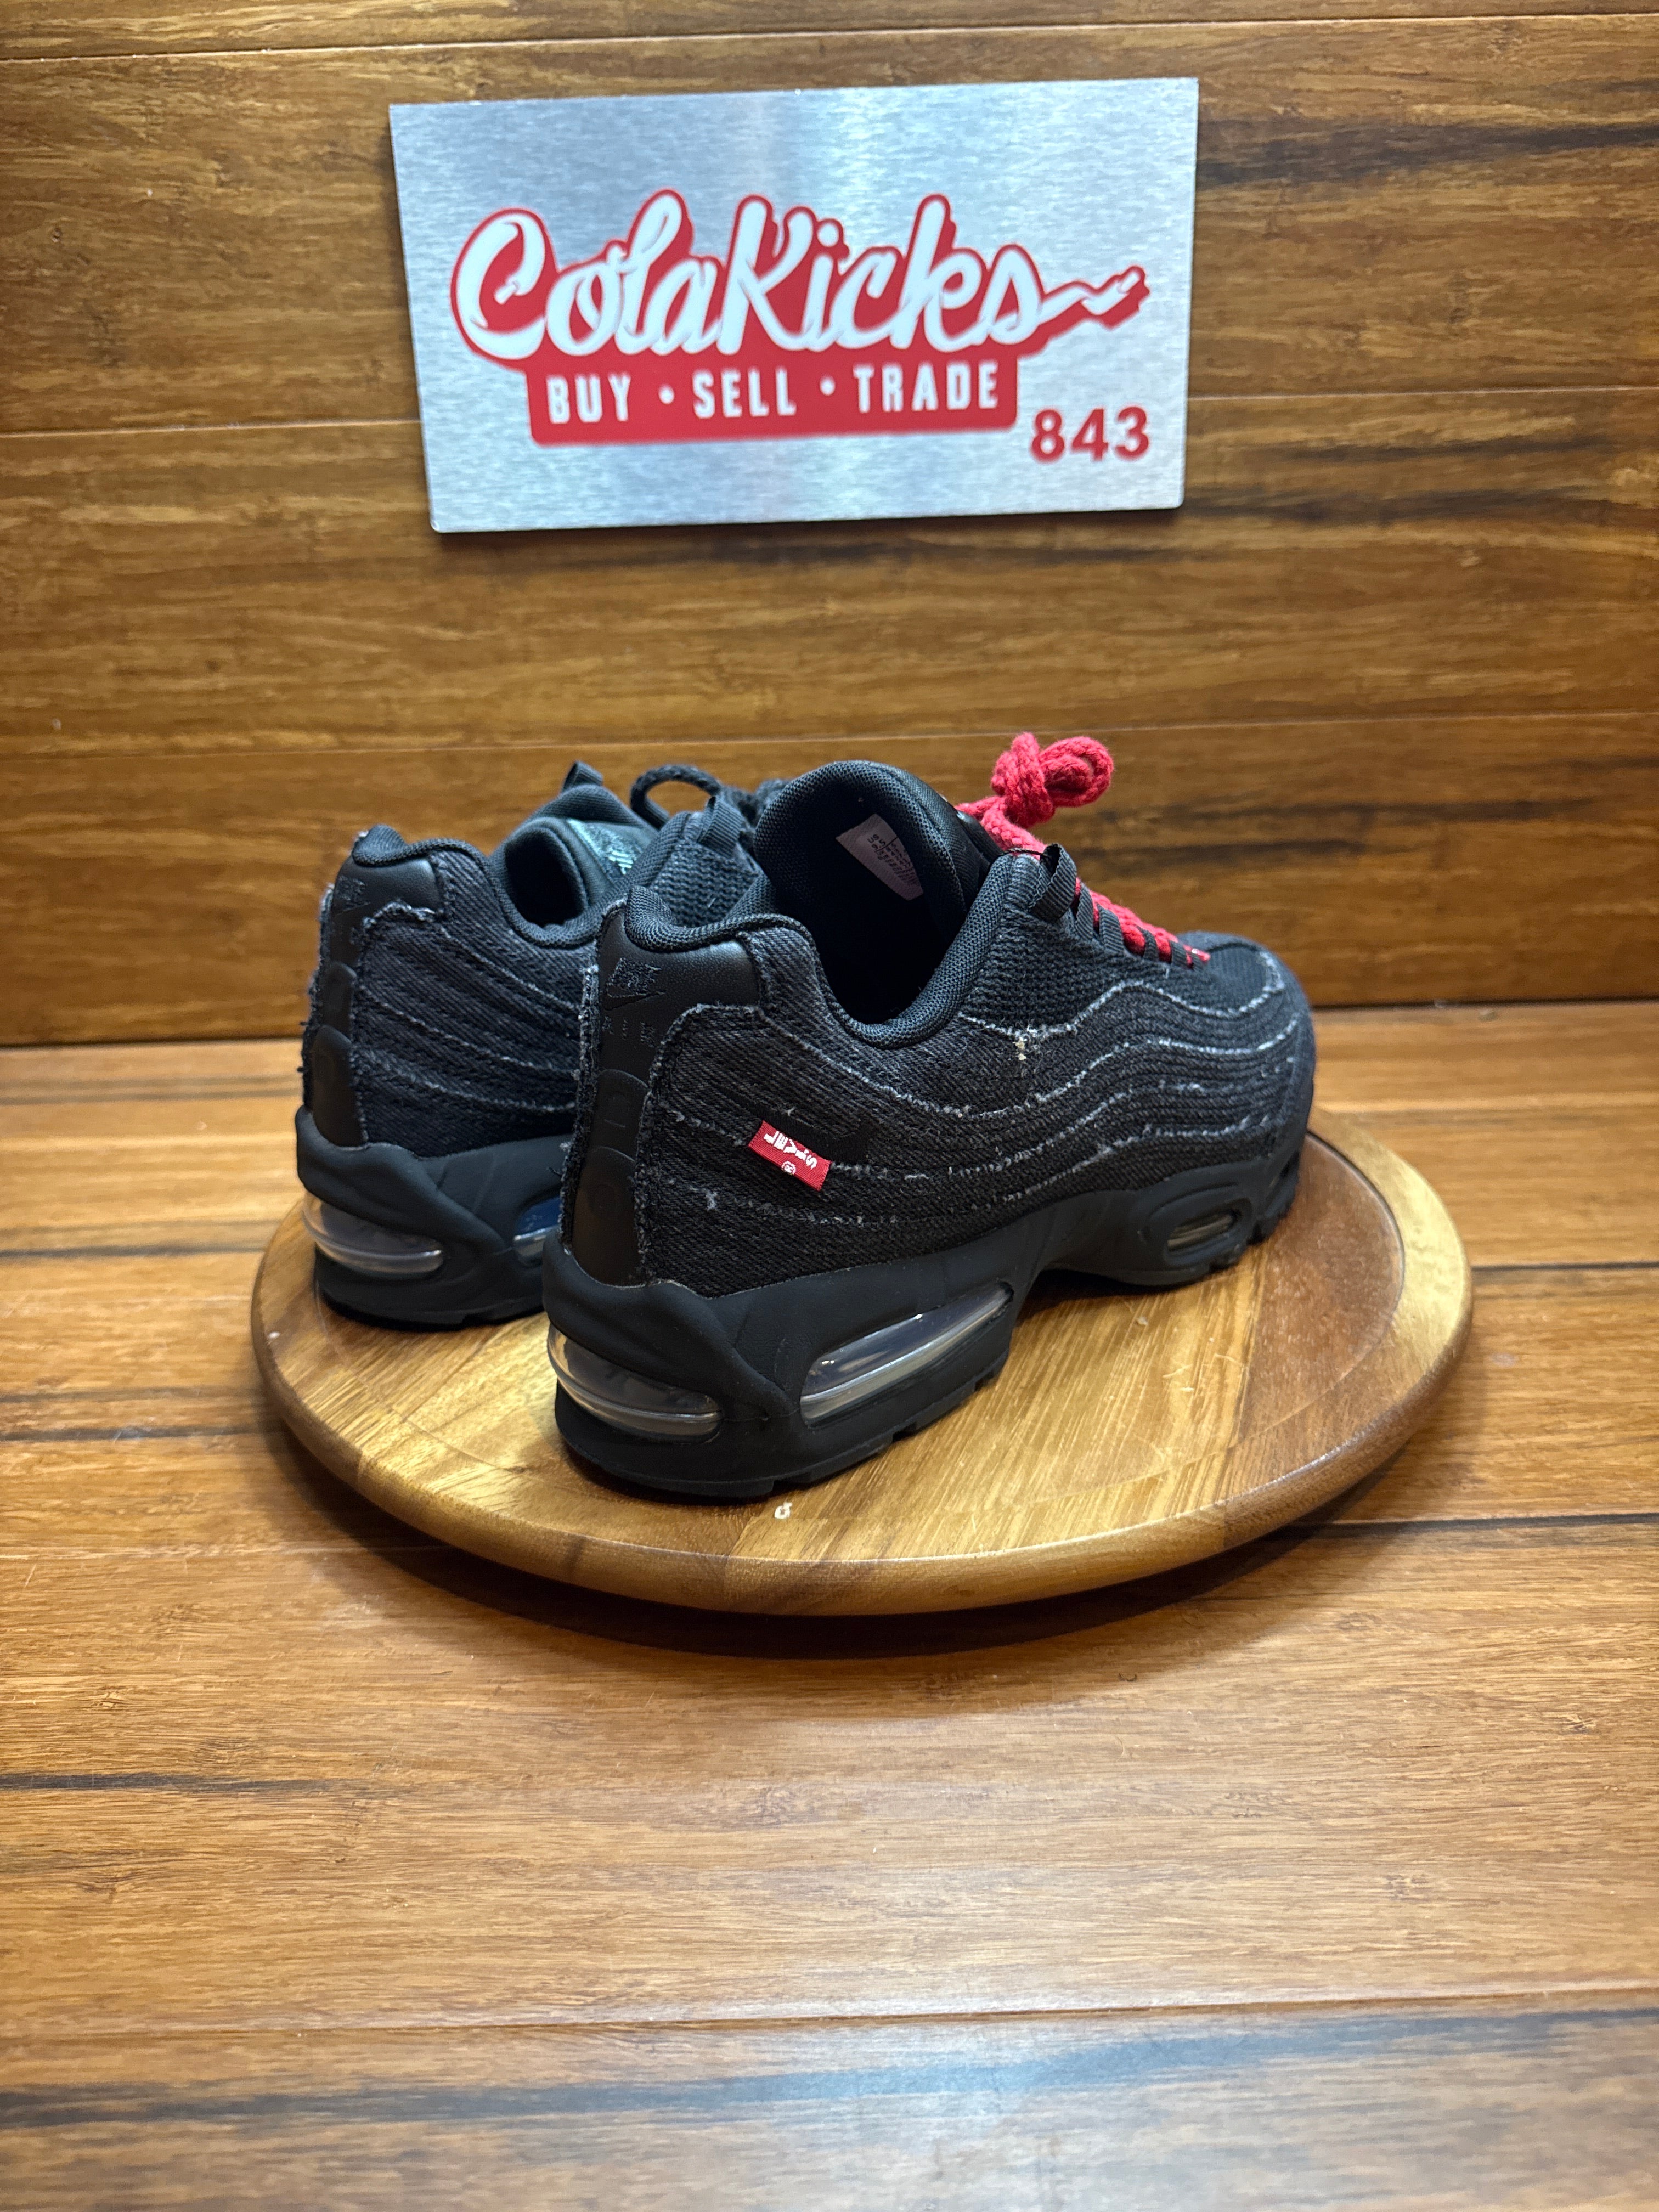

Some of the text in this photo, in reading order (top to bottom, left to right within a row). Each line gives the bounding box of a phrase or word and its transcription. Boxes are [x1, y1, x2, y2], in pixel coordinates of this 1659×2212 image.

[451, 189, 1149, 364] ColaKicks
[546, 364, 1000, 424] BUY SELL TRADE
[1030, 406, 1150, 462] 843
[867, 834, 879, 843] US
